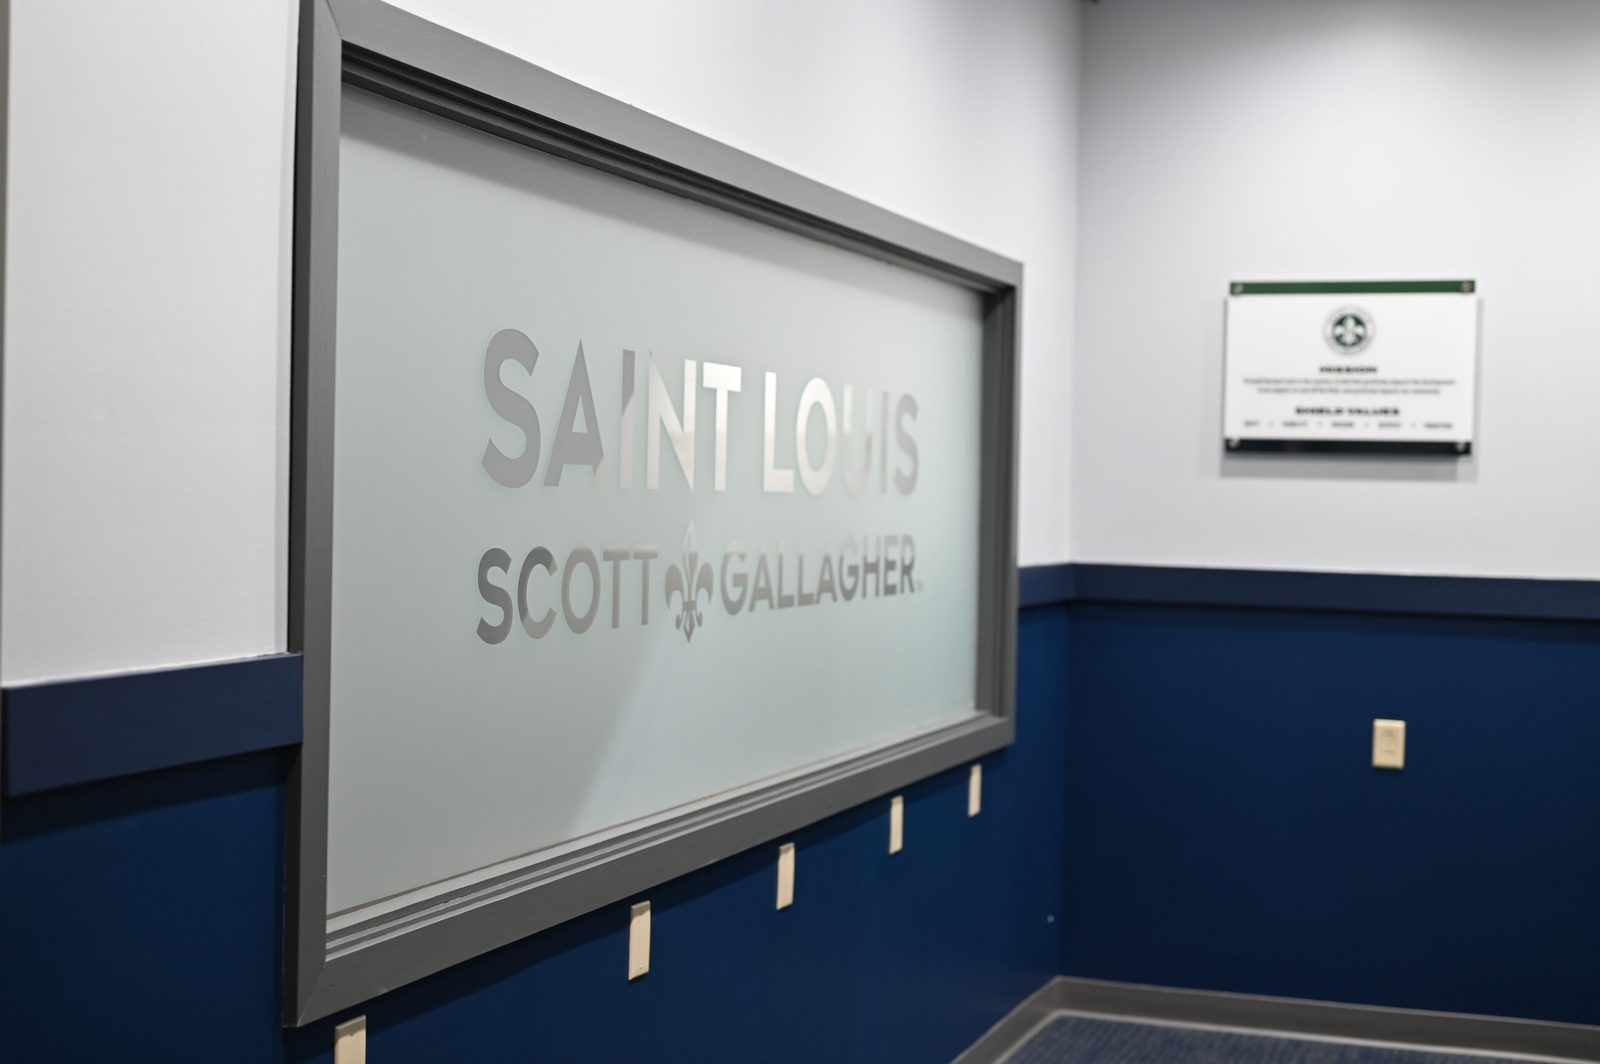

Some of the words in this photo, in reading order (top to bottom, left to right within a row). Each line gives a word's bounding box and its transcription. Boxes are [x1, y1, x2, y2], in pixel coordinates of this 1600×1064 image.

[481, 328, 742, 493] SAINT
[763, 370, 919, 496] LOUIS
[476, 543, 659, 645] SCOTT
[720, 534, 915, 615] GALLAGHER
